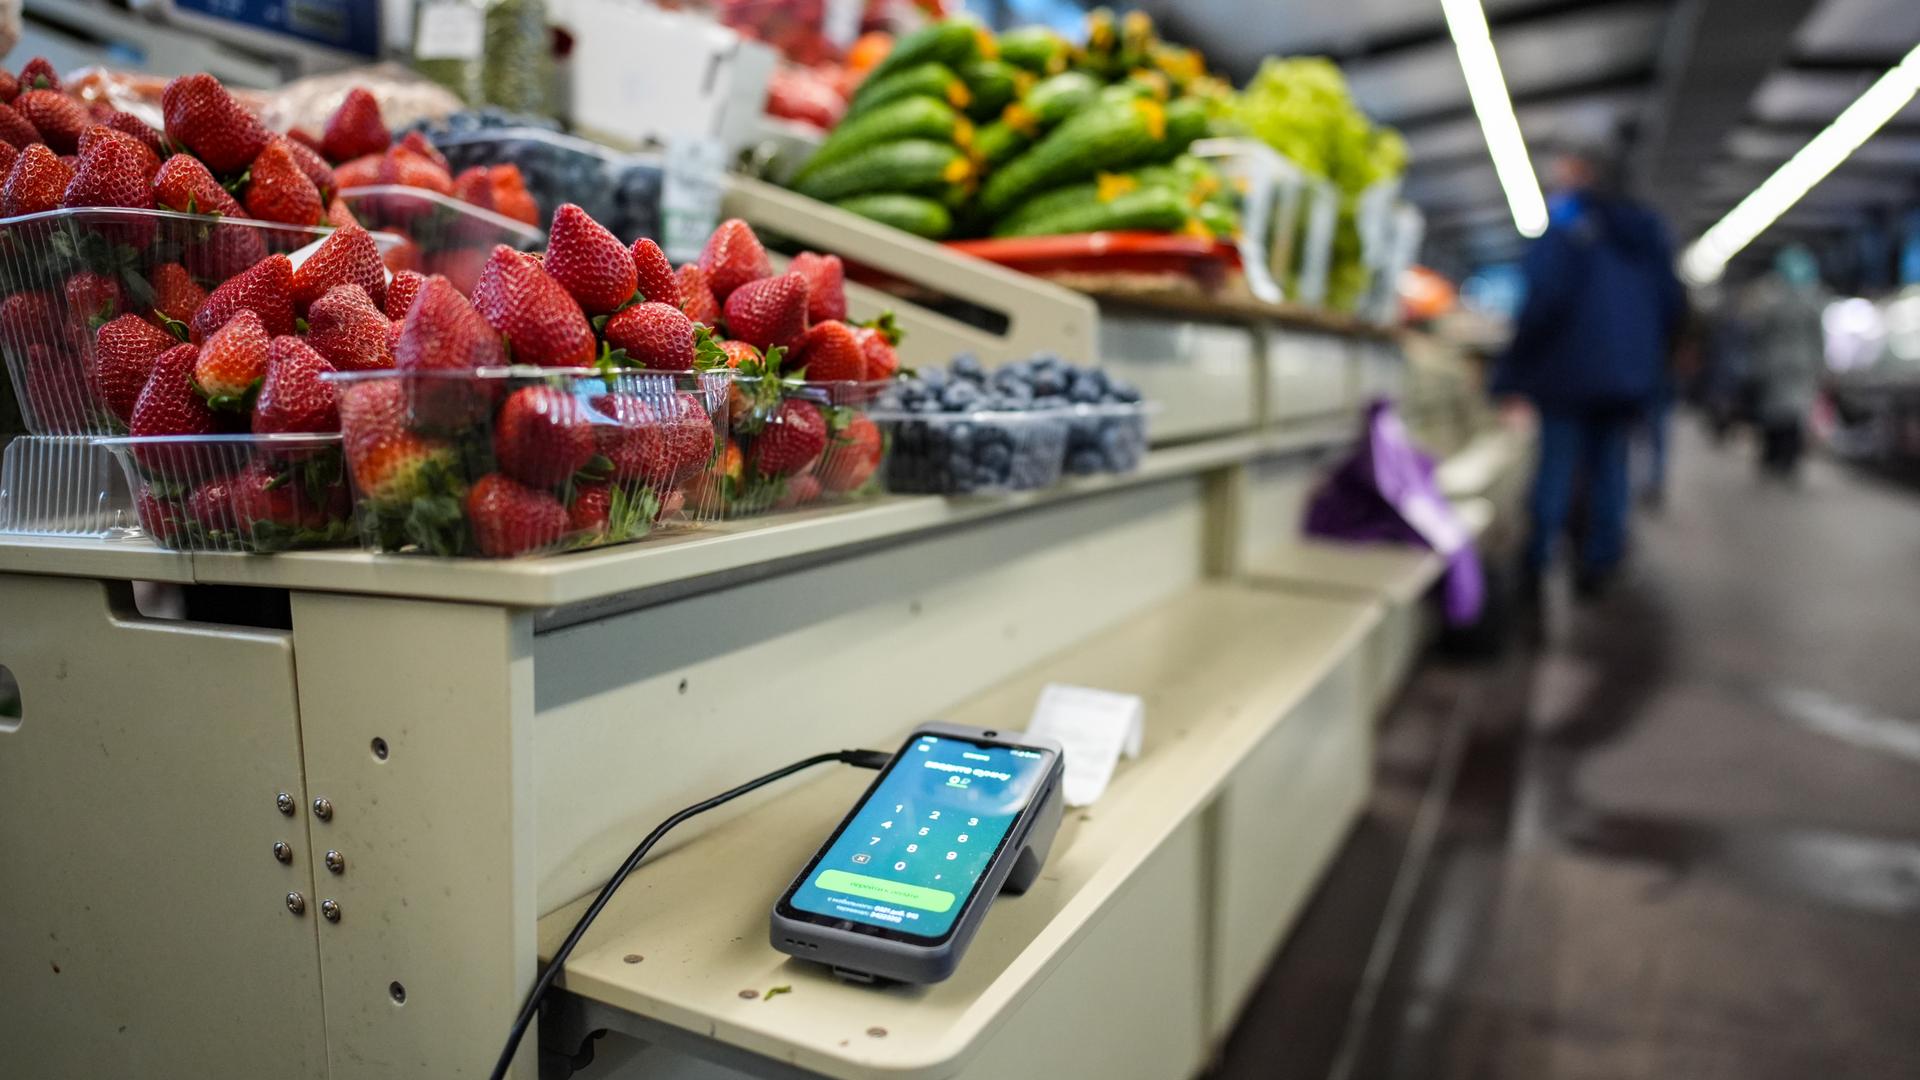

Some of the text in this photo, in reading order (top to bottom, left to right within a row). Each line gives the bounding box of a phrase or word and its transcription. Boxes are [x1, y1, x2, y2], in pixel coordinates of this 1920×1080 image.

[948, 775, 961, 784] 0
[895, 804, 978, 826] 1 2 3
[881, 820, 968, 843] 4 5 6
[869, 836, 957, 860] 7 8 9
[894, 861, 906, 871] 0
